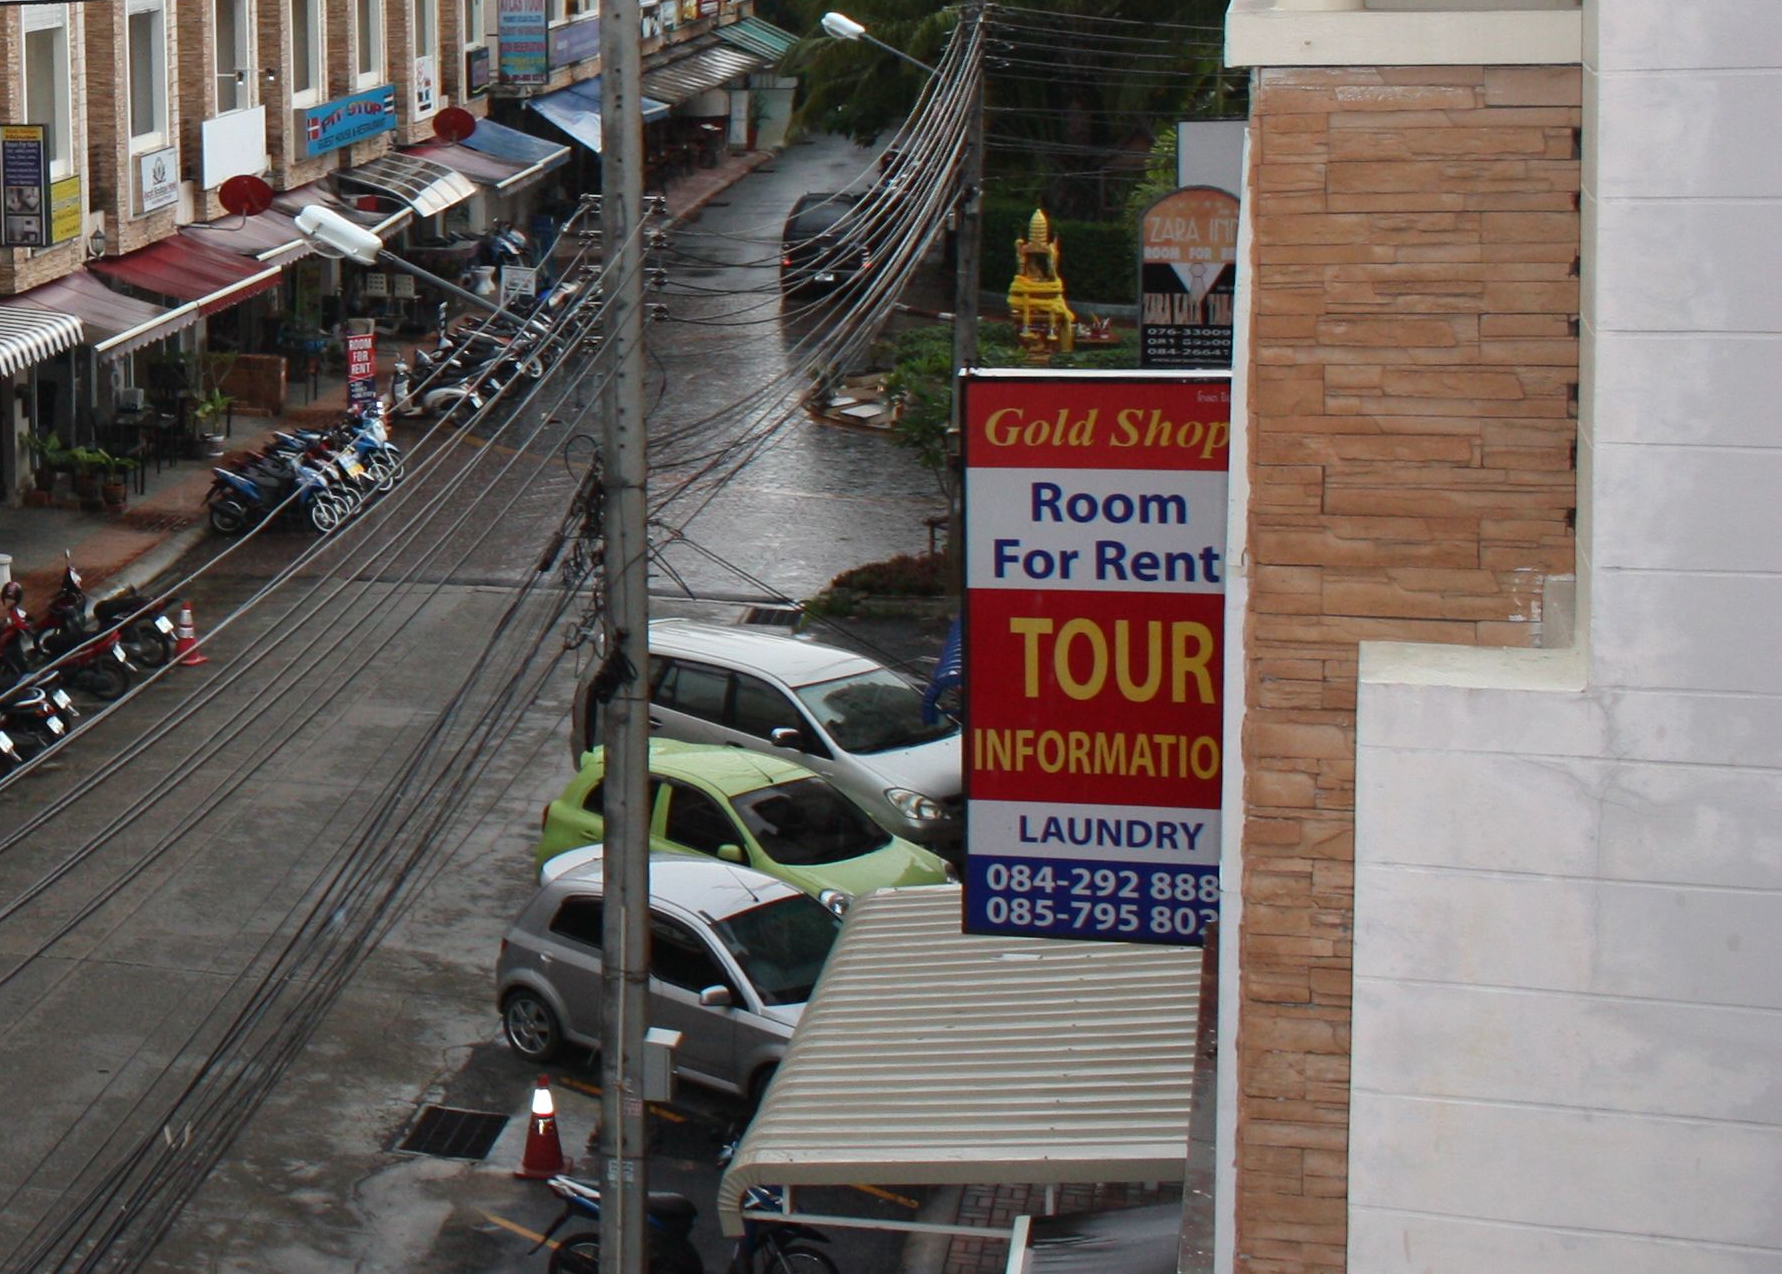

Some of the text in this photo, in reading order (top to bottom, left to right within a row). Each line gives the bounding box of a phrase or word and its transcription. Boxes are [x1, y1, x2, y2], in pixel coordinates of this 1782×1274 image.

[321, 100, 383, 133] PIT STOP
[1150, 217, 1199, 243] ZARA
[1143, 246, 1181, 259] ROOM
[1189, 246, 1211, 259] FOR
[349, 337, 372, 351] ROOM
[1147, 328, 1231, 336] 076-33009
[351, 362, 370, 375] RENT
[353, 350, 369, 362] FOR
[984, 407, 1230, 459] Gold Shop
[1031, 482, 1187, 524] Room
[993, 539, 1221, 583] For Rent
[1009, 617, 1216, 704] TOUR
[974, 728, 1219, 780] INFORMATIO
[1019, 814, 1204, 851] LAUNDRY
[986, 863, 1219, 903] 084-292 888
[986, 897, 1140, 932] 085-795
